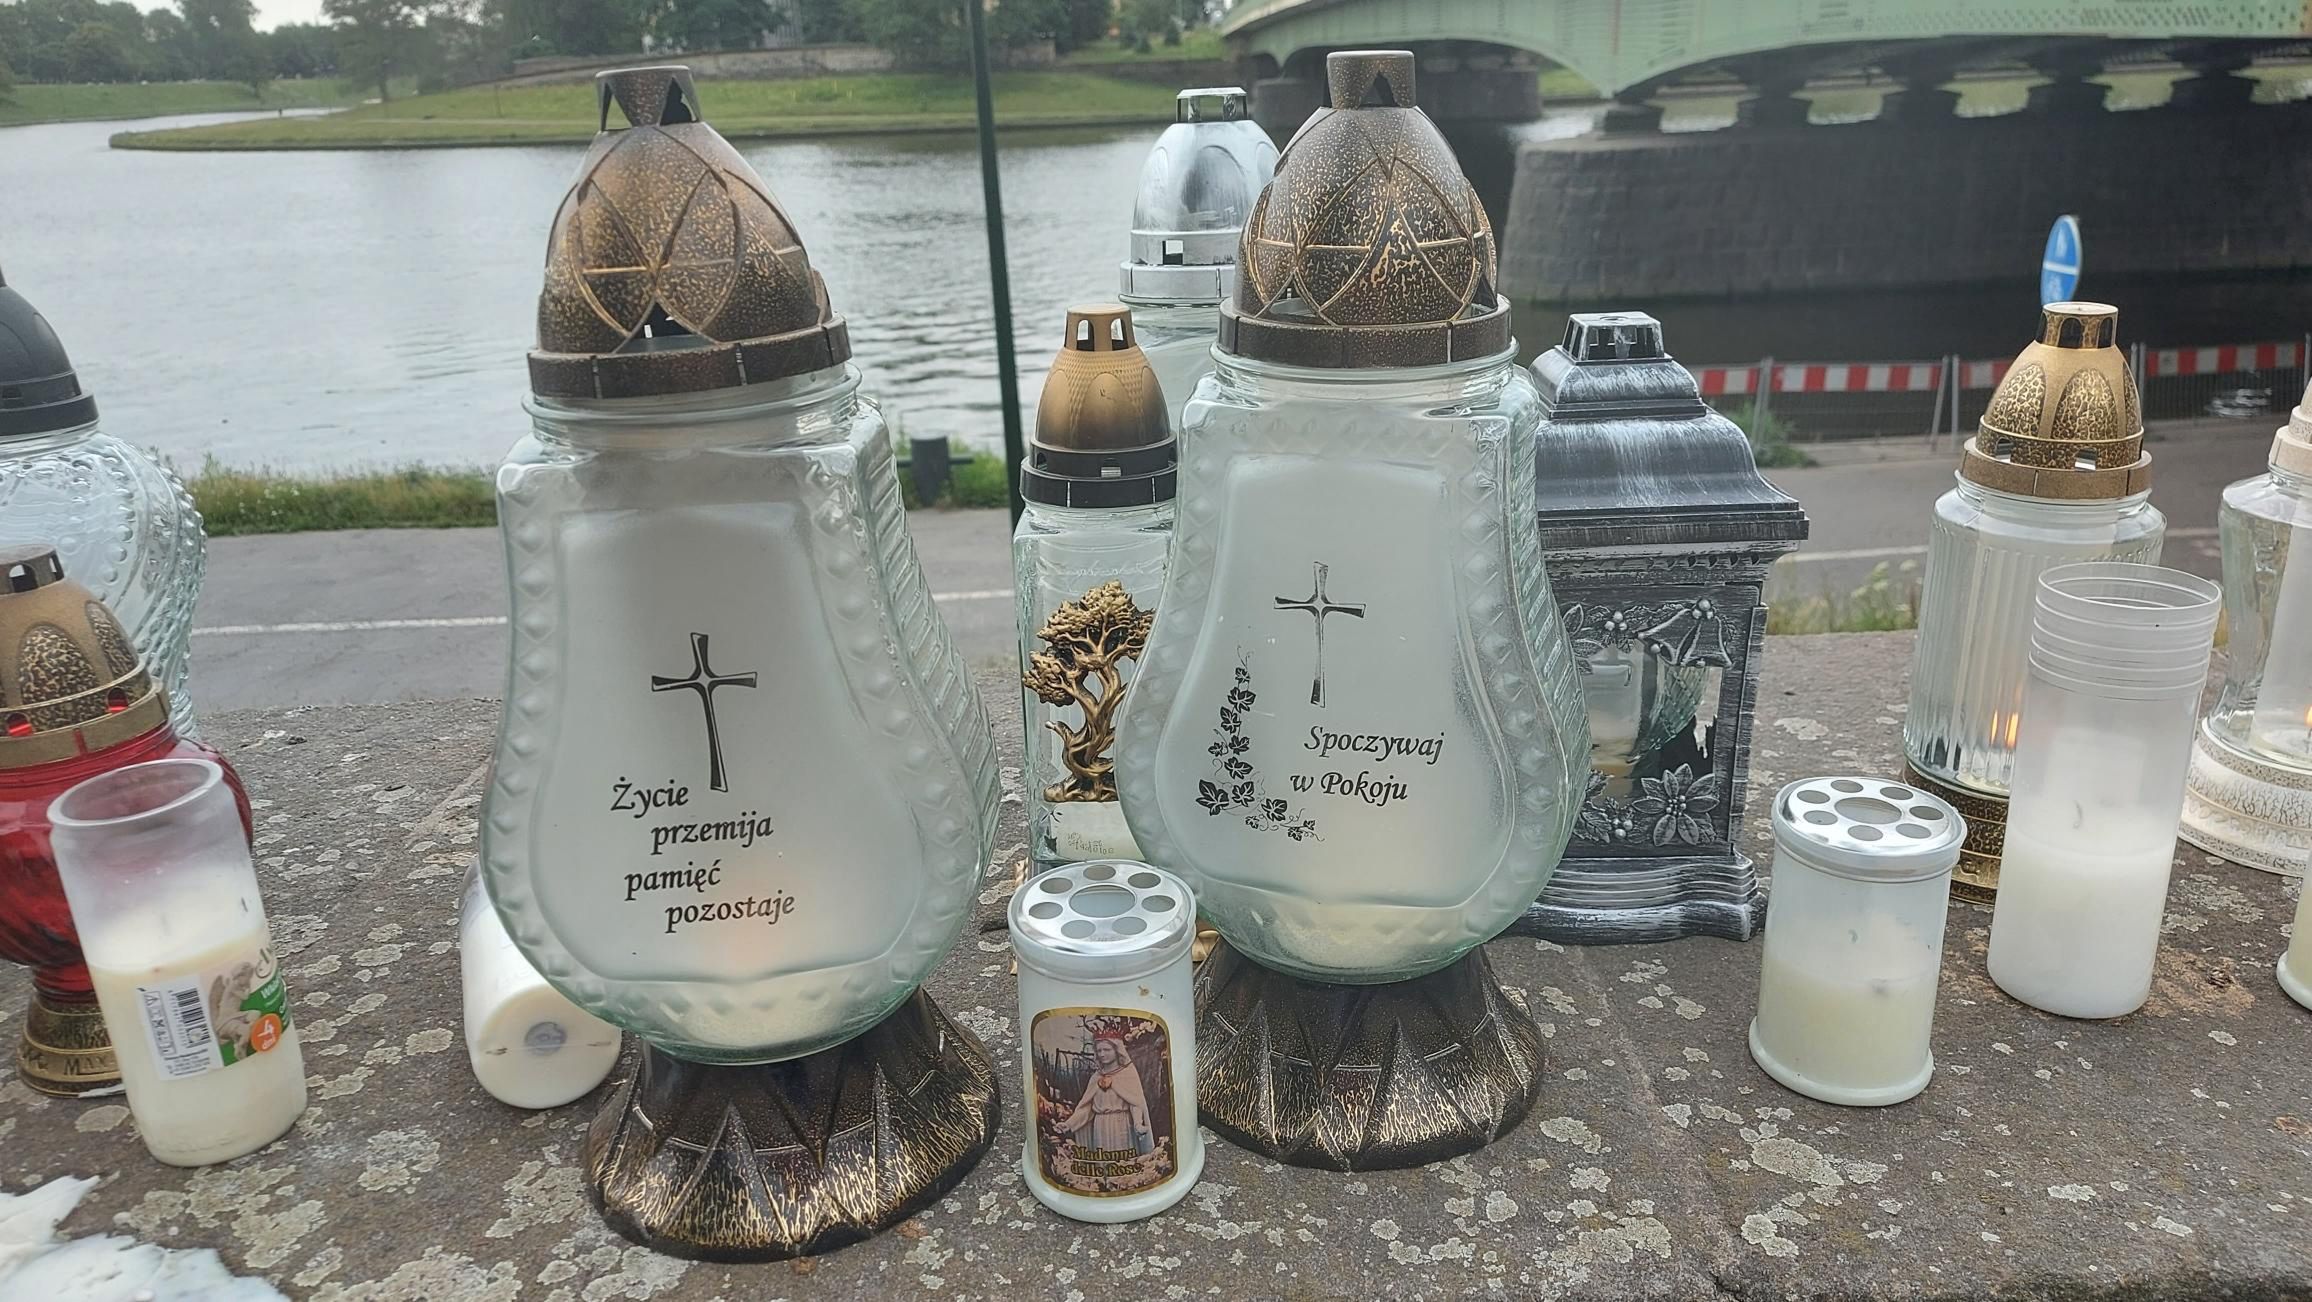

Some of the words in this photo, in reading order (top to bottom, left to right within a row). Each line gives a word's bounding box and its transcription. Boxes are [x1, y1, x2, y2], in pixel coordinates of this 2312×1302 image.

[1303, 724, 1445, 765] Spoczywaj
[609, 775, 690, 819] Życie
[1289, 773, 1314, 793] w
[1320, 770, 1409, 806] Pokoju
[650, 809, 774, 855] przemija
[623, 858, 722, 901] pamięć
[664, 888, 796, 934] pozostaje
[1071, 1145, 1138, 1162] Madonna
[1071, 1160, 1104, 1177] delle
